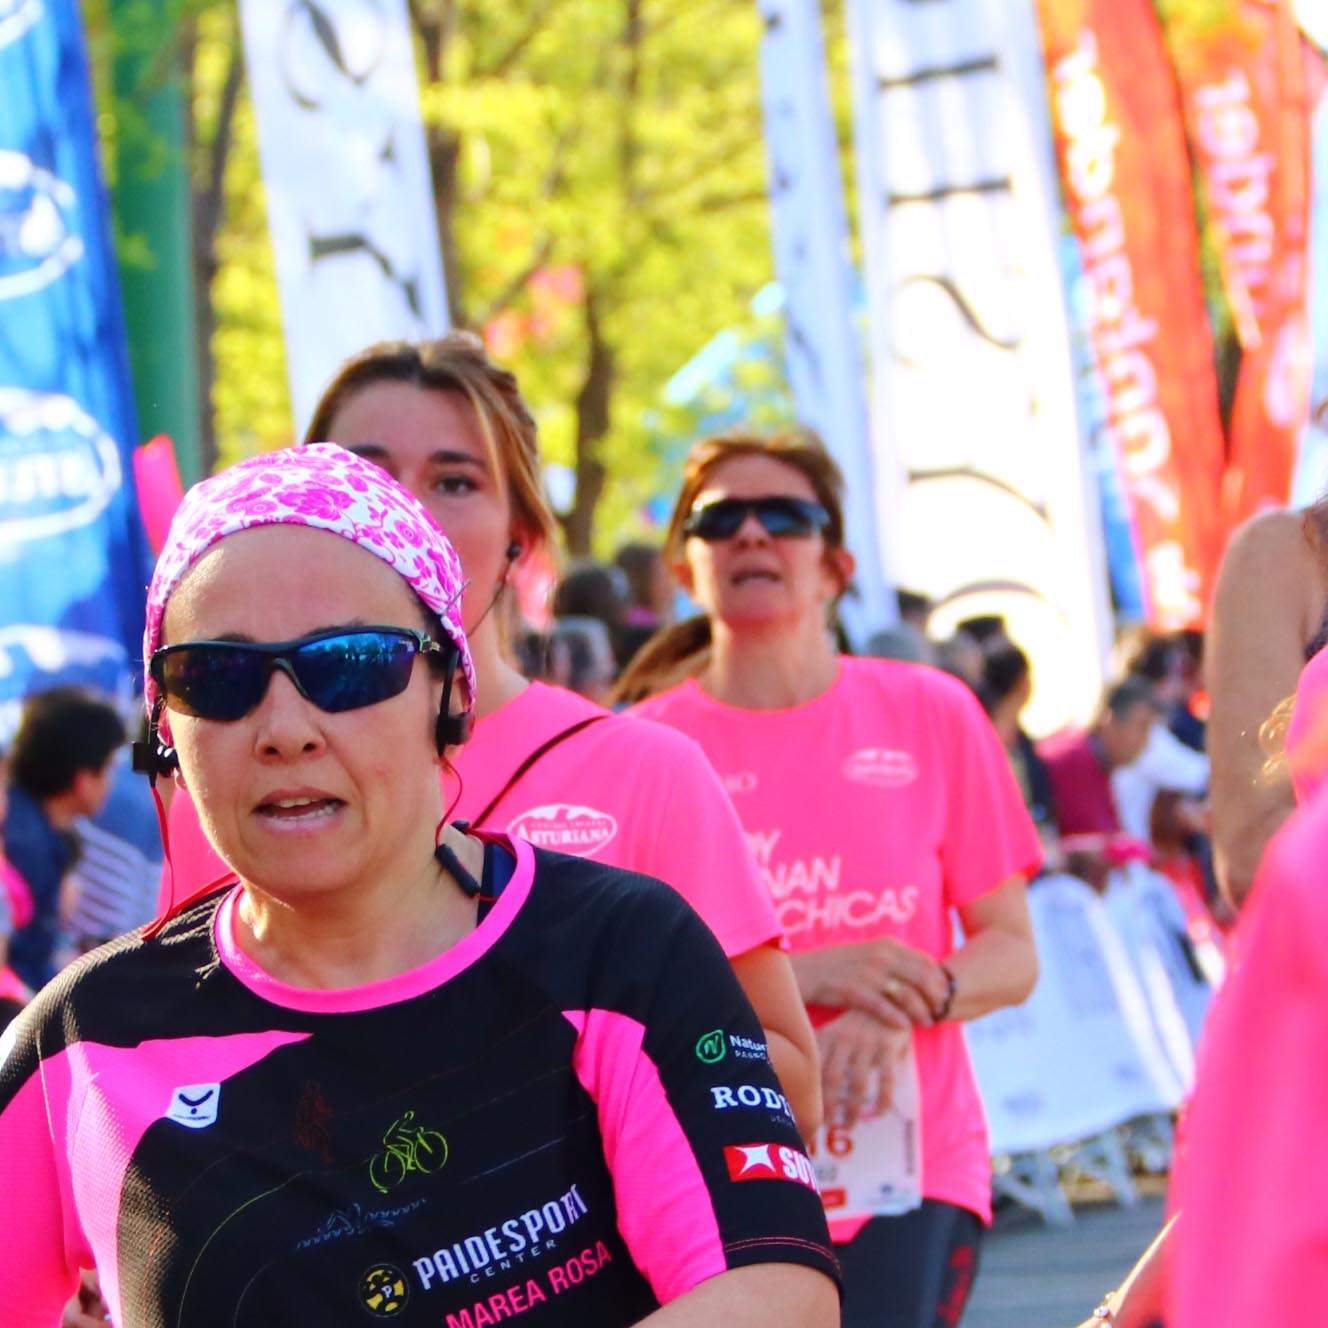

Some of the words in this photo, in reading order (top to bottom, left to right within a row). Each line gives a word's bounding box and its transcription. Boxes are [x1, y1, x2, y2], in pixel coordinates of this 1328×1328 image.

[518, 823, 610, 845] ASTURIANA
[774, 885, 919, 936] CHICAS
[413, 1184, 589, 1290] PAIDESPORT
[469, 1239, 557, 1284] CENTER
[547, 1240, 614, 1294] ROSA
